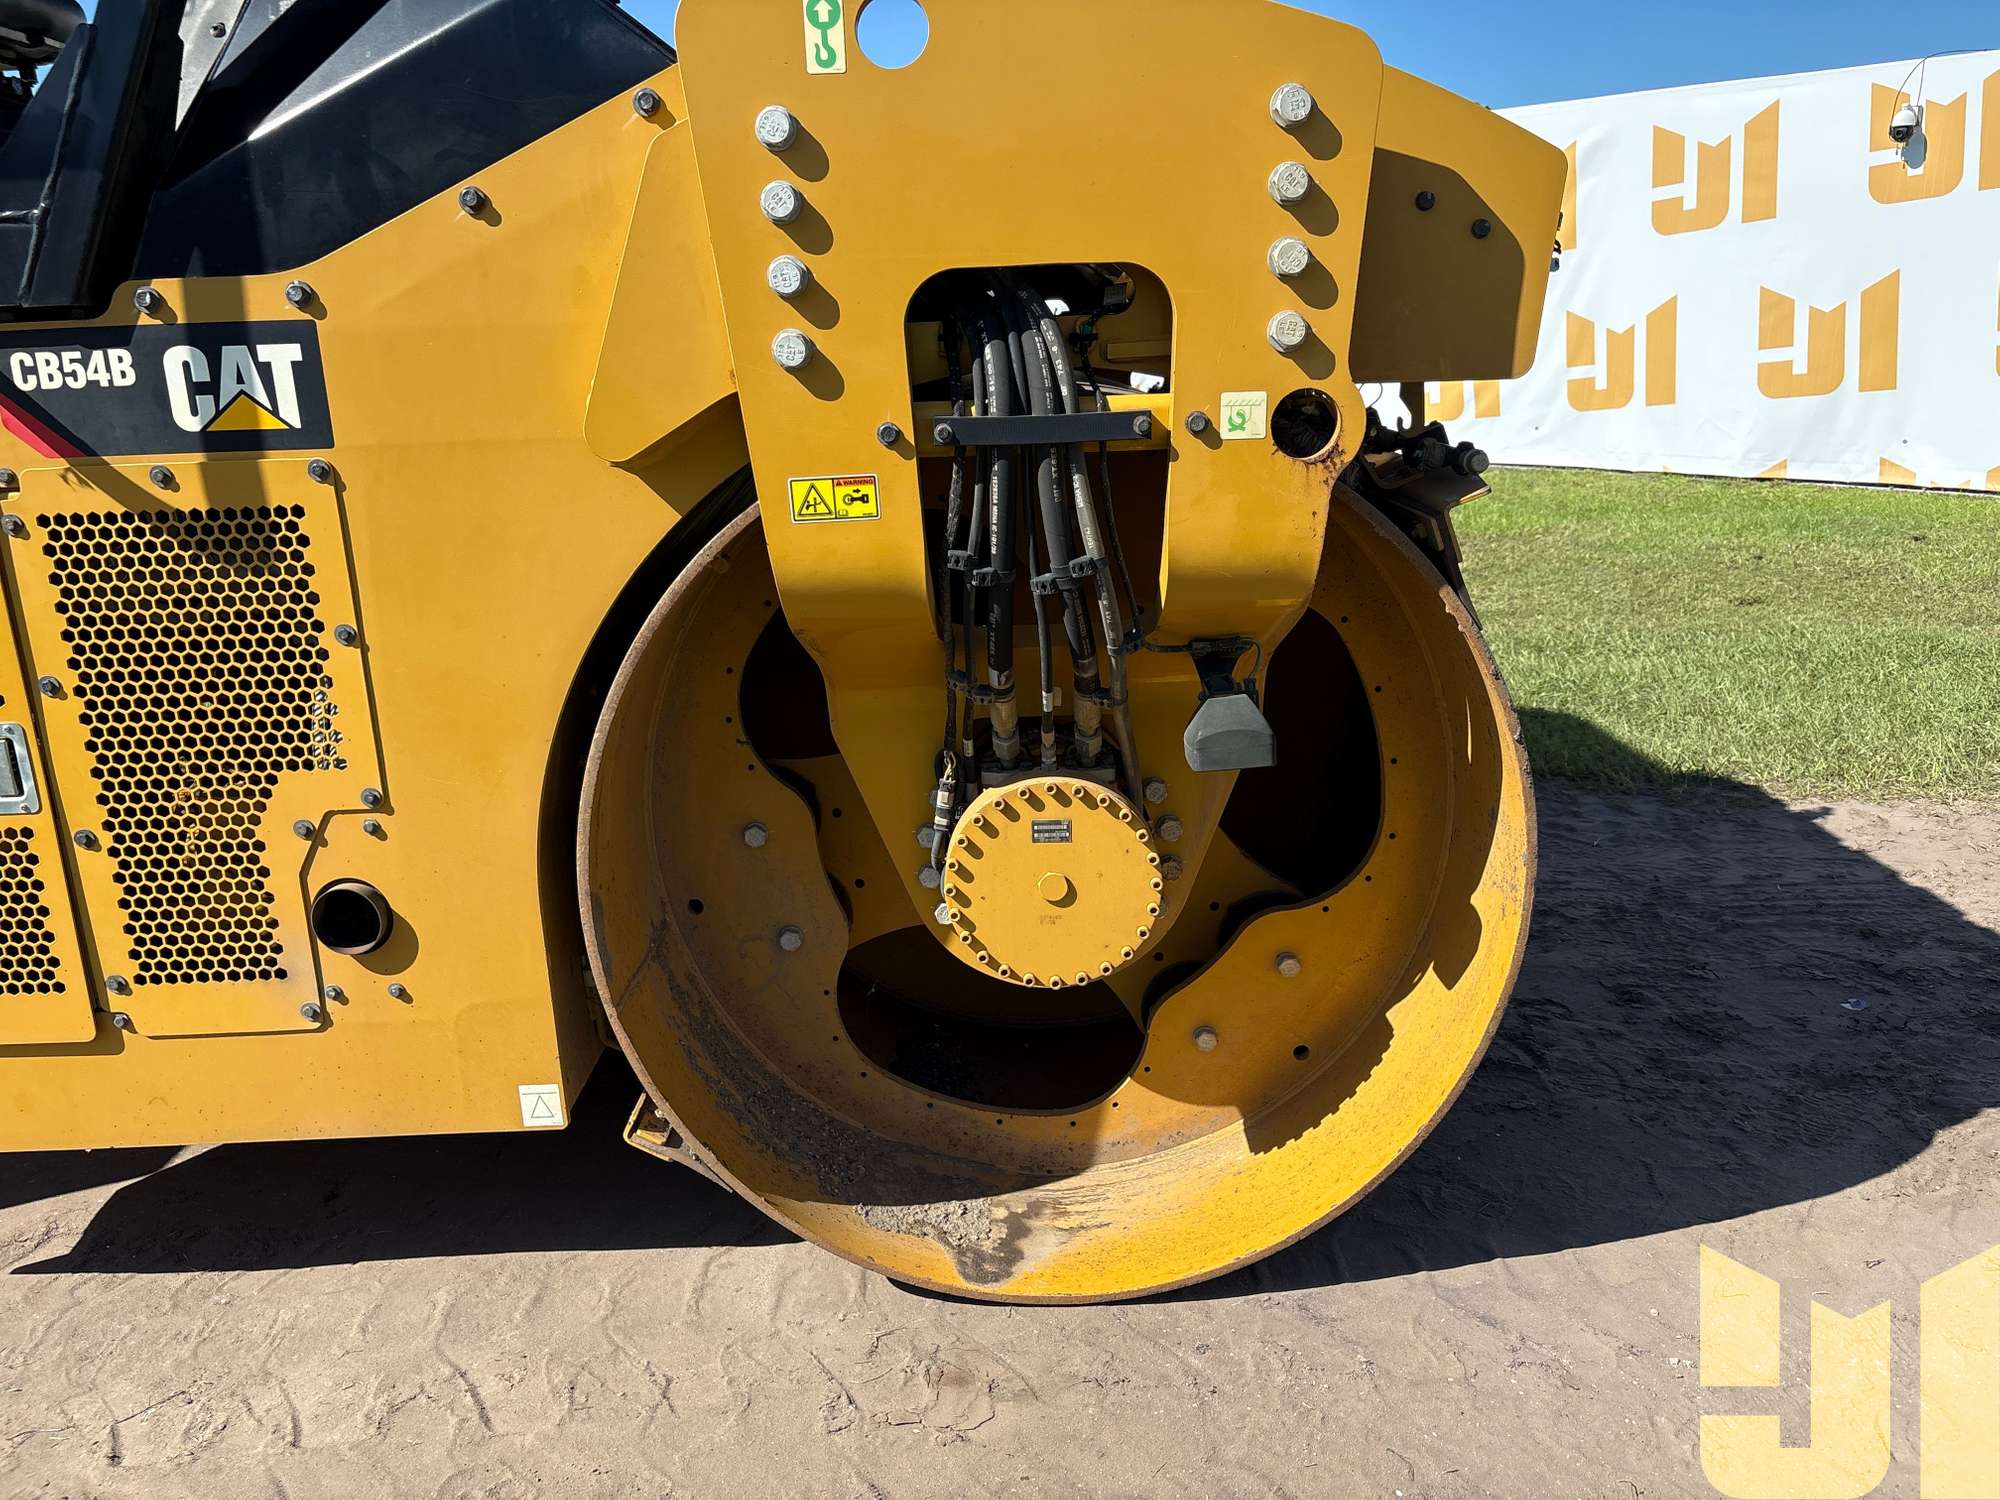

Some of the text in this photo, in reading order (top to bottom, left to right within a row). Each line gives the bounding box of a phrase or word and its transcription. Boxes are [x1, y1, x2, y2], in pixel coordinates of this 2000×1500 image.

[10, 348, 137, 392] CB54B
[163, 343, 303, 432] CAT
[843, 478, 873, 486] WARNING
